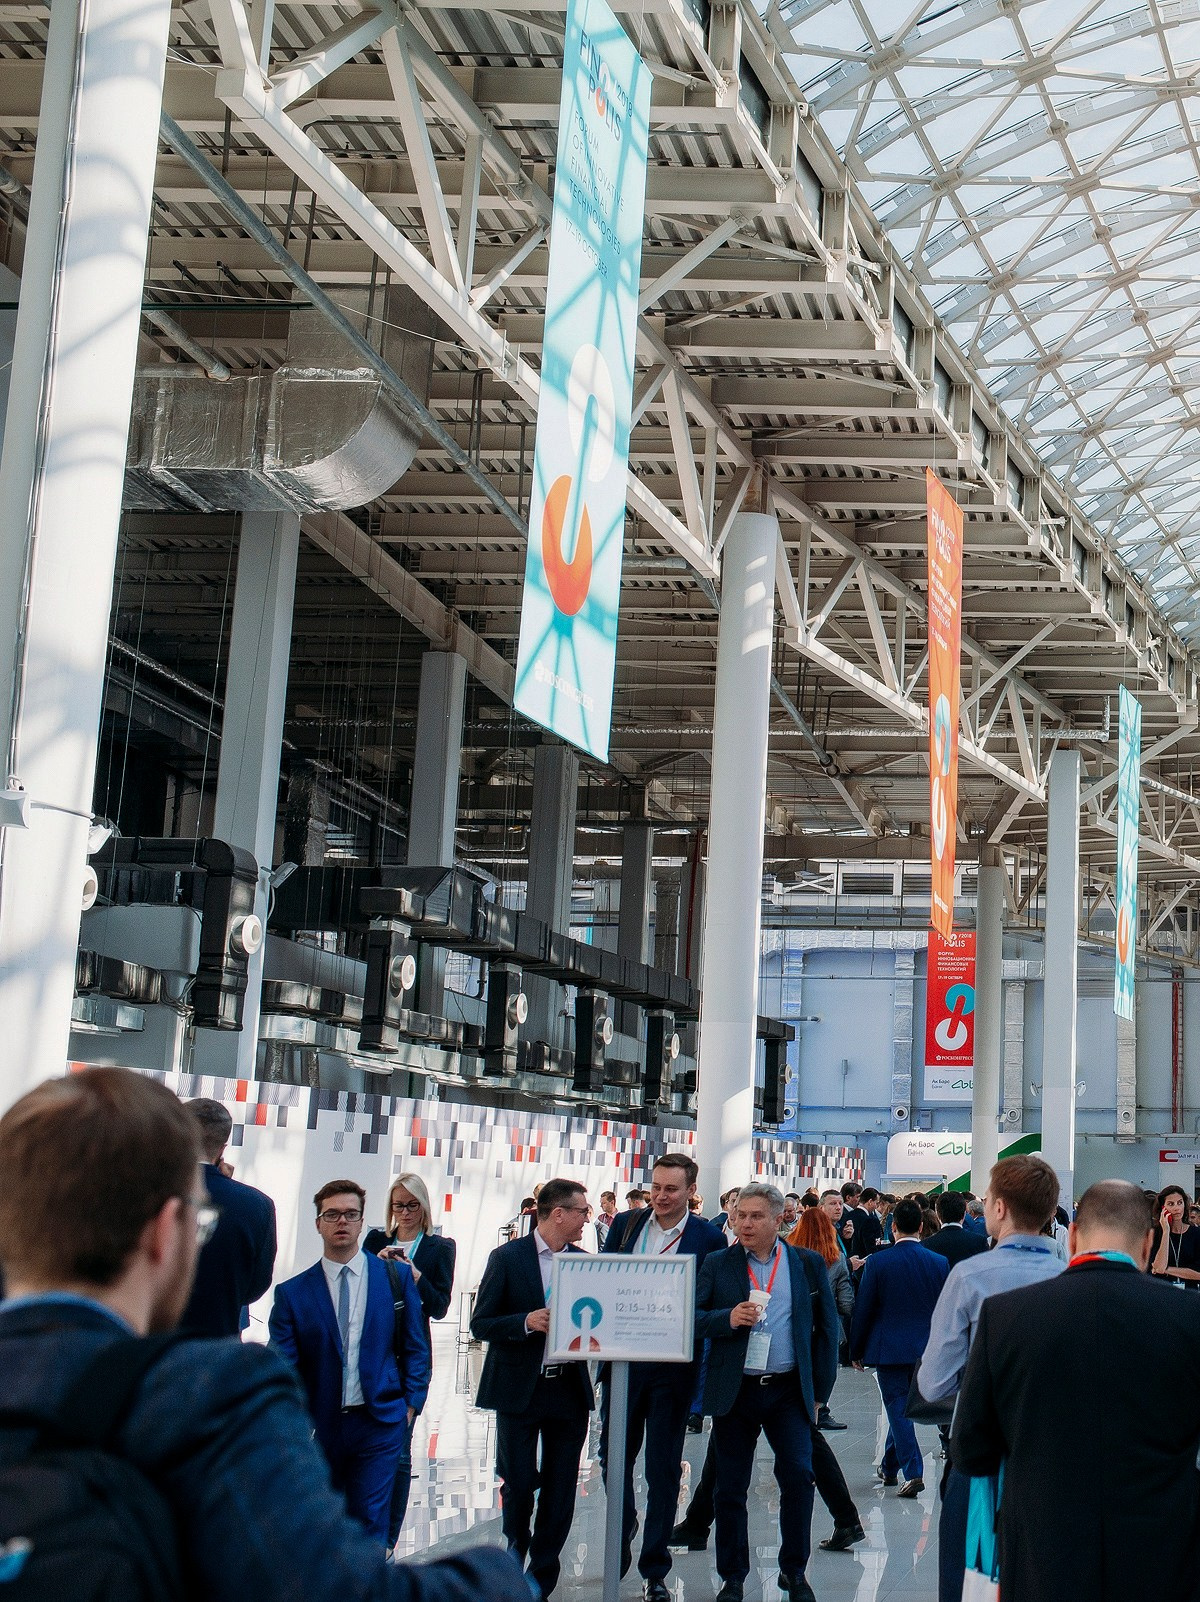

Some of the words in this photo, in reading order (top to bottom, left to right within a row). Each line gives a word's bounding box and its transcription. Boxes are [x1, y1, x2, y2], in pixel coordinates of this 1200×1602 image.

[575, 111, 599, 153] FORUM
[570, 155, 608, 215] FINANCIAL
[572, 134, 583, 154] OF
[585, 148, 625, 213] INNOVATIVE
[569, 177, 621, 255] TECHNOLOGIES
[582, 239, 608, 279] OCTOBER
[918, 1141, 935, 1149] Барс
[616, 1288, 631, 1296] ЗАЛ
